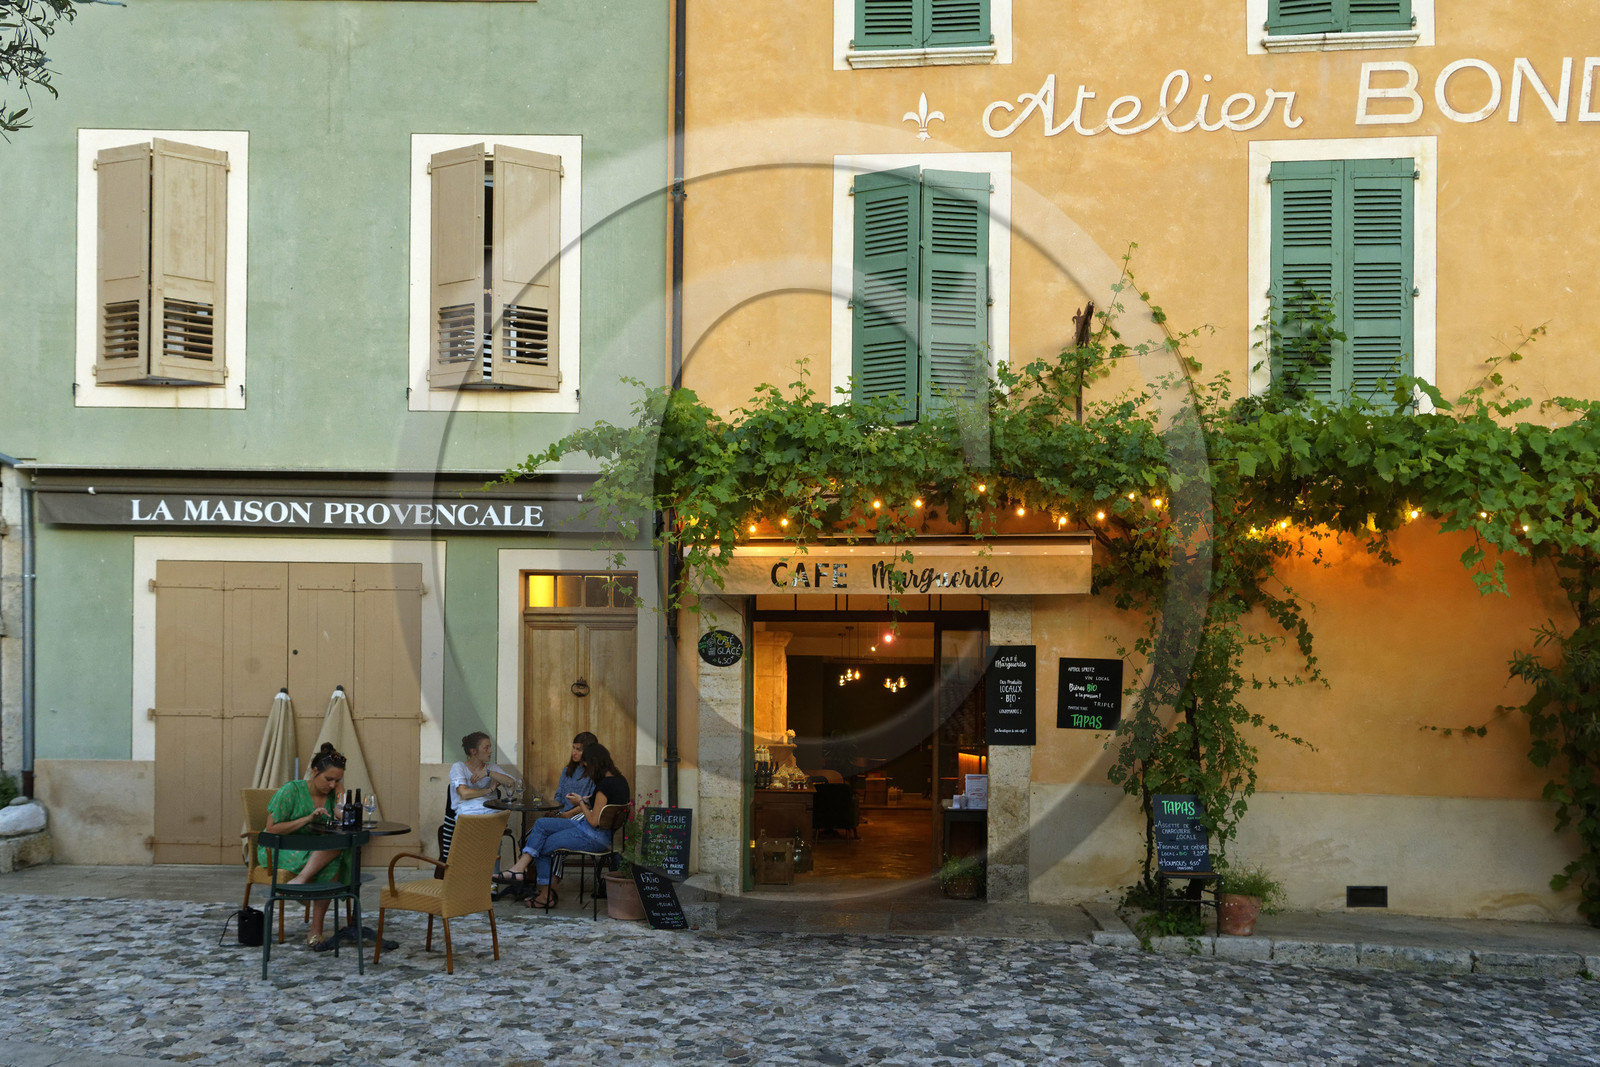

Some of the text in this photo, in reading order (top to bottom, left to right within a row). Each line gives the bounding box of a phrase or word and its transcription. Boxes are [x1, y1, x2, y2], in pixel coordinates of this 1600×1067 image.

[982, 69, 1304, 138] Atelier
[130, 499, 544, 528] LA MAISON PROVENCALE
[770, 561, 848, 589] CAFE
[994, 659, 1027, 670] Marguerite
[1001, 654, 1018, 662] CAFÉ
[999, 685, 1022, 693] LOCAUX
[1070, 714, 1103, 730] TAPAS
[1161, 800, 1196, 816] TAPAS
